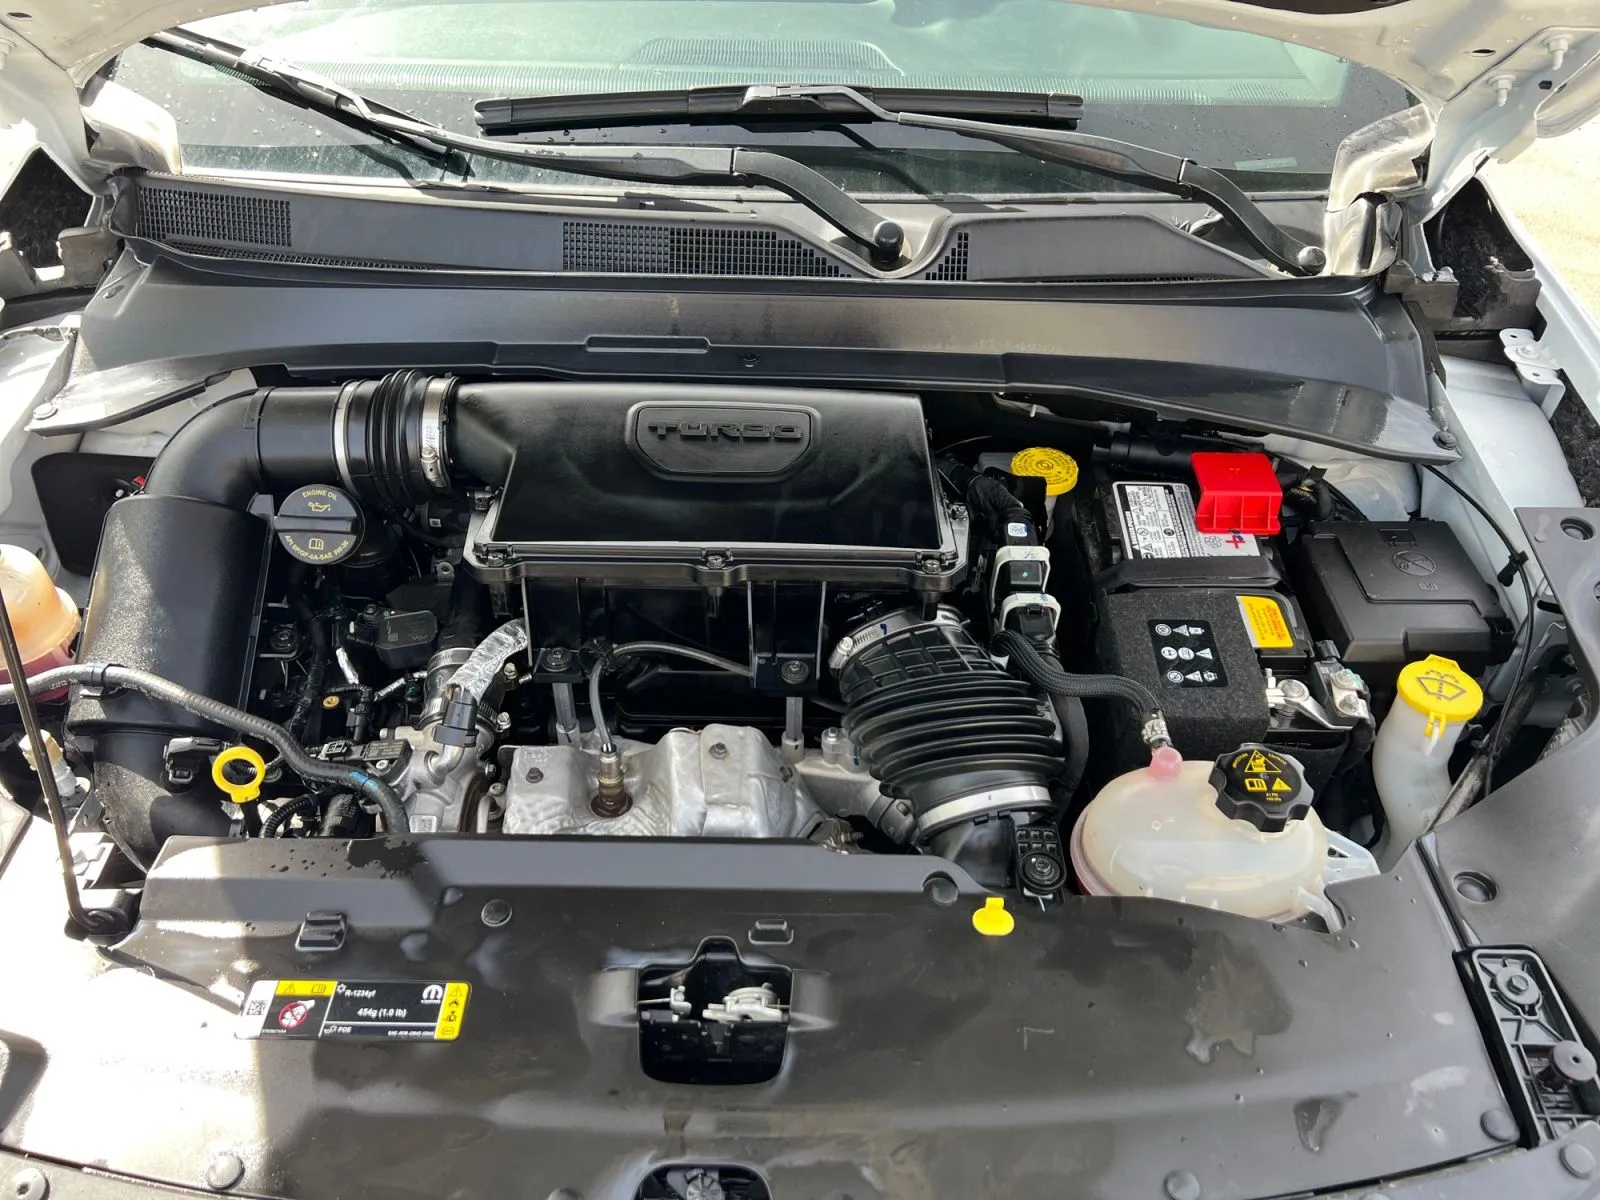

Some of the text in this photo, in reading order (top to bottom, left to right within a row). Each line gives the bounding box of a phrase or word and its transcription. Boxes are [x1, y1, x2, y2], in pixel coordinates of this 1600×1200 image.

[648, 422, 802, 440] TURBO
[302, 489, 337, 501] ENGINE OIL
[284, 535, 294, 546] API
[344, 989, 376, 999] R-1234yf
[357, 1008, 407, 1019] 454g (1.0 lb)
